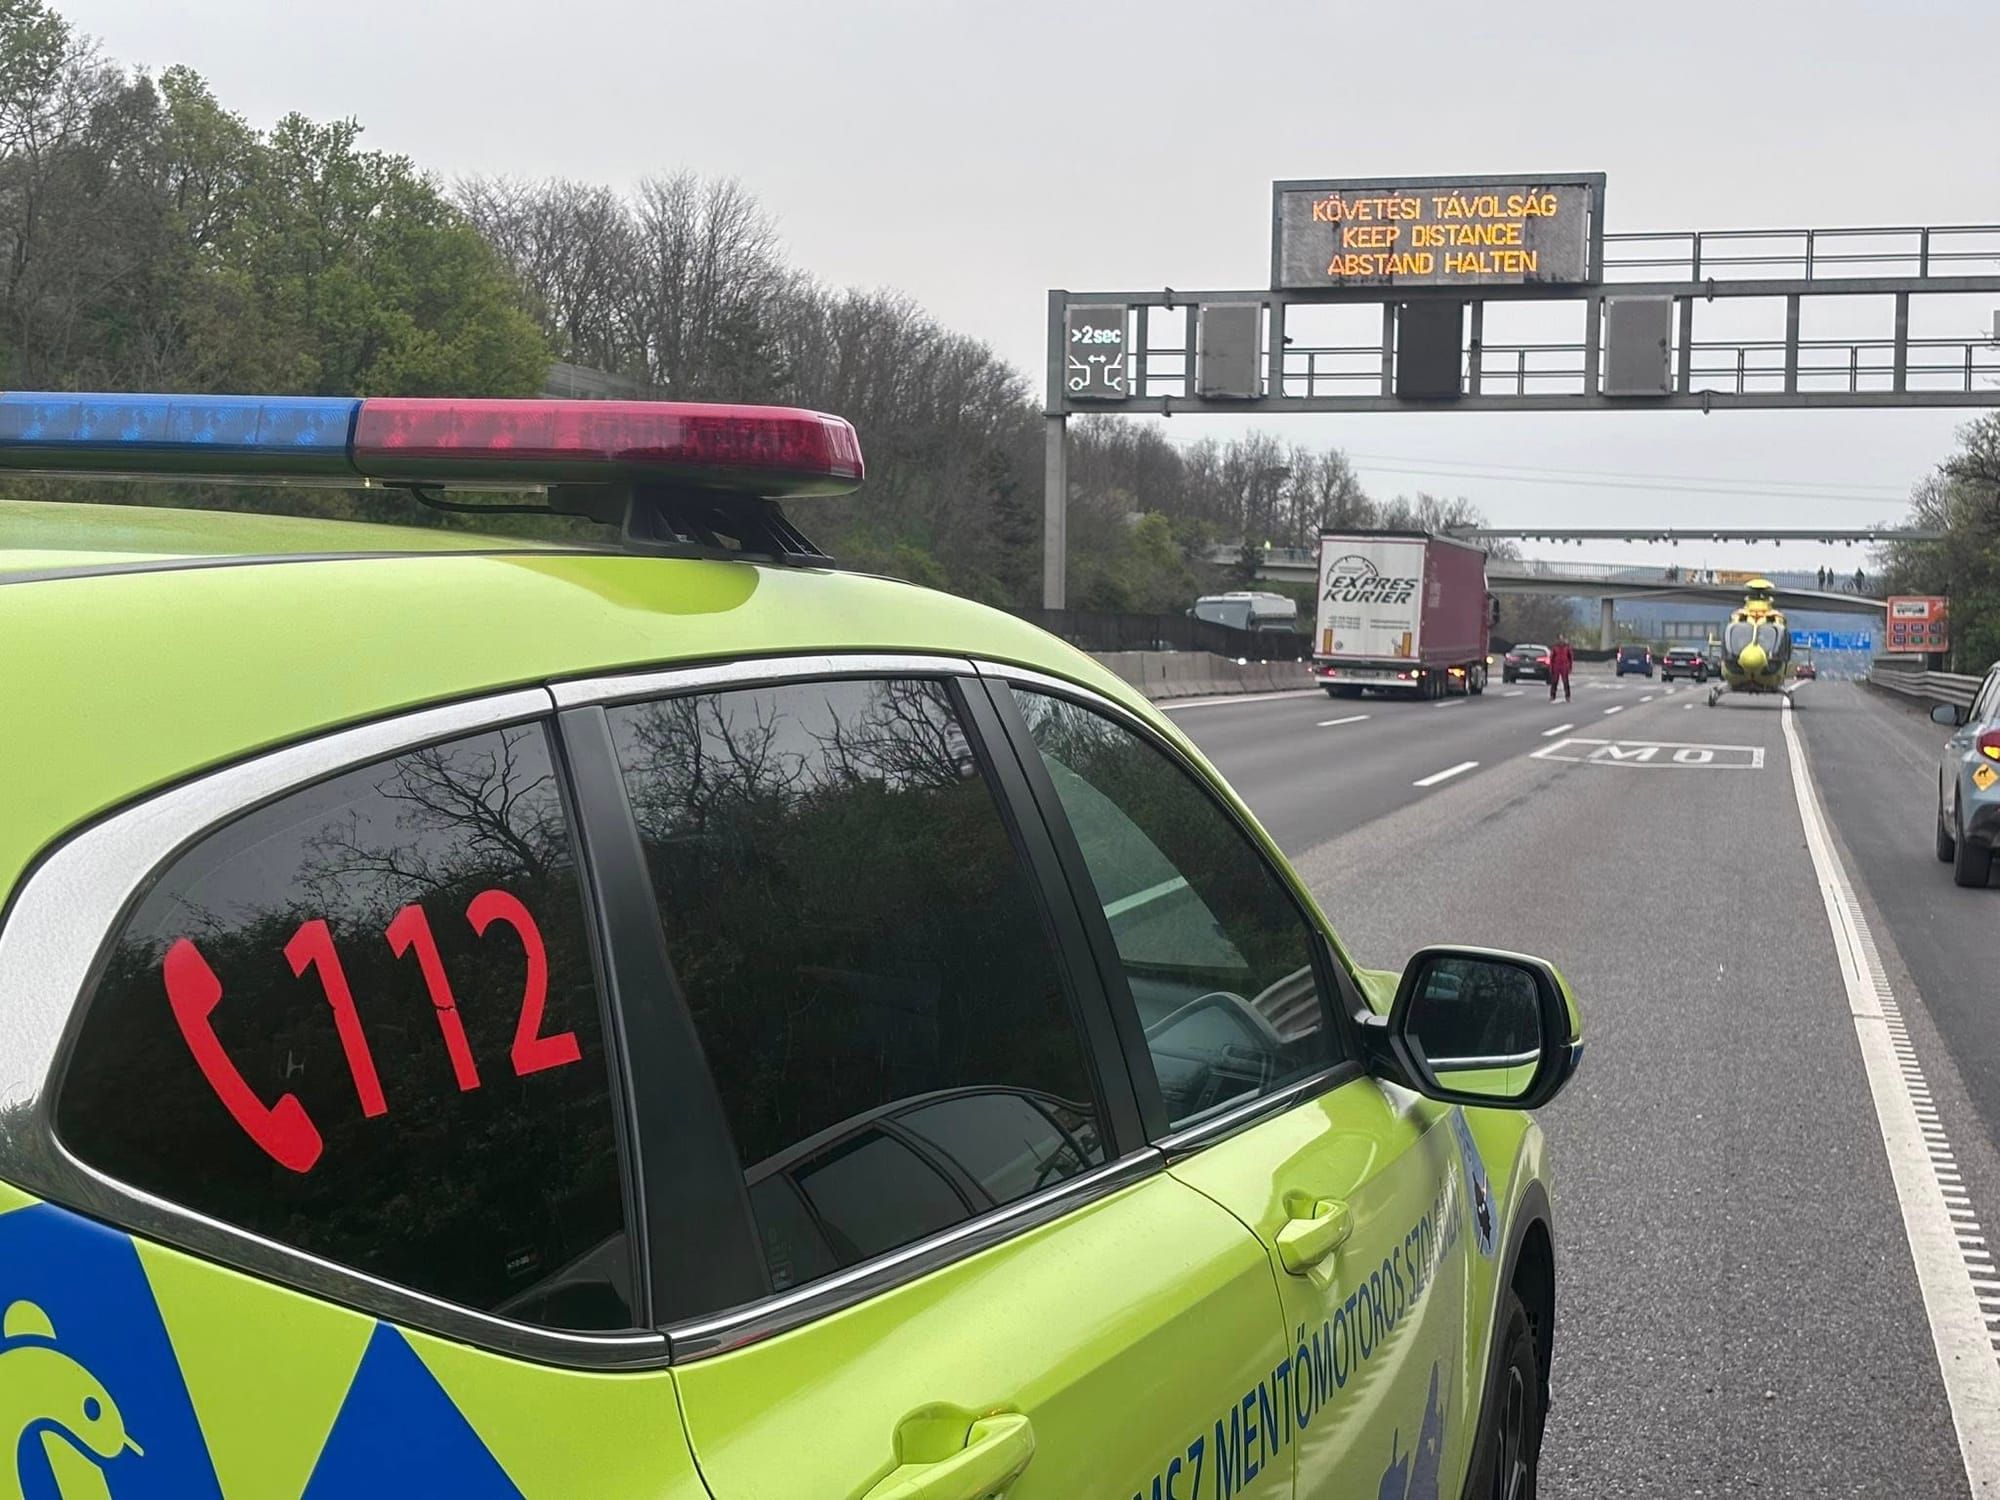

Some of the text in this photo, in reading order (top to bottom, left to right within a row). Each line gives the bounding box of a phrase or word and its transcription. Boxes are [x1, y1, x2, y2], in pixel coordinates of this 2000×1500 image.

[1312, 188, 1558, 222] KÖVETÉSI TÁVOLSÁG
[1342, 223, 1524, 248] KEEP DISTANCE
[1327, 250, 1538, 276] ABSTAND HALTEN
[1331, 575, 1418, 591] EXPRES
[1323, 588, 1413, 605] KURIER
[283, 888, 582, 1118] 112
[1214, 1245, 1405, 1500] MENTŐMOTOROS
